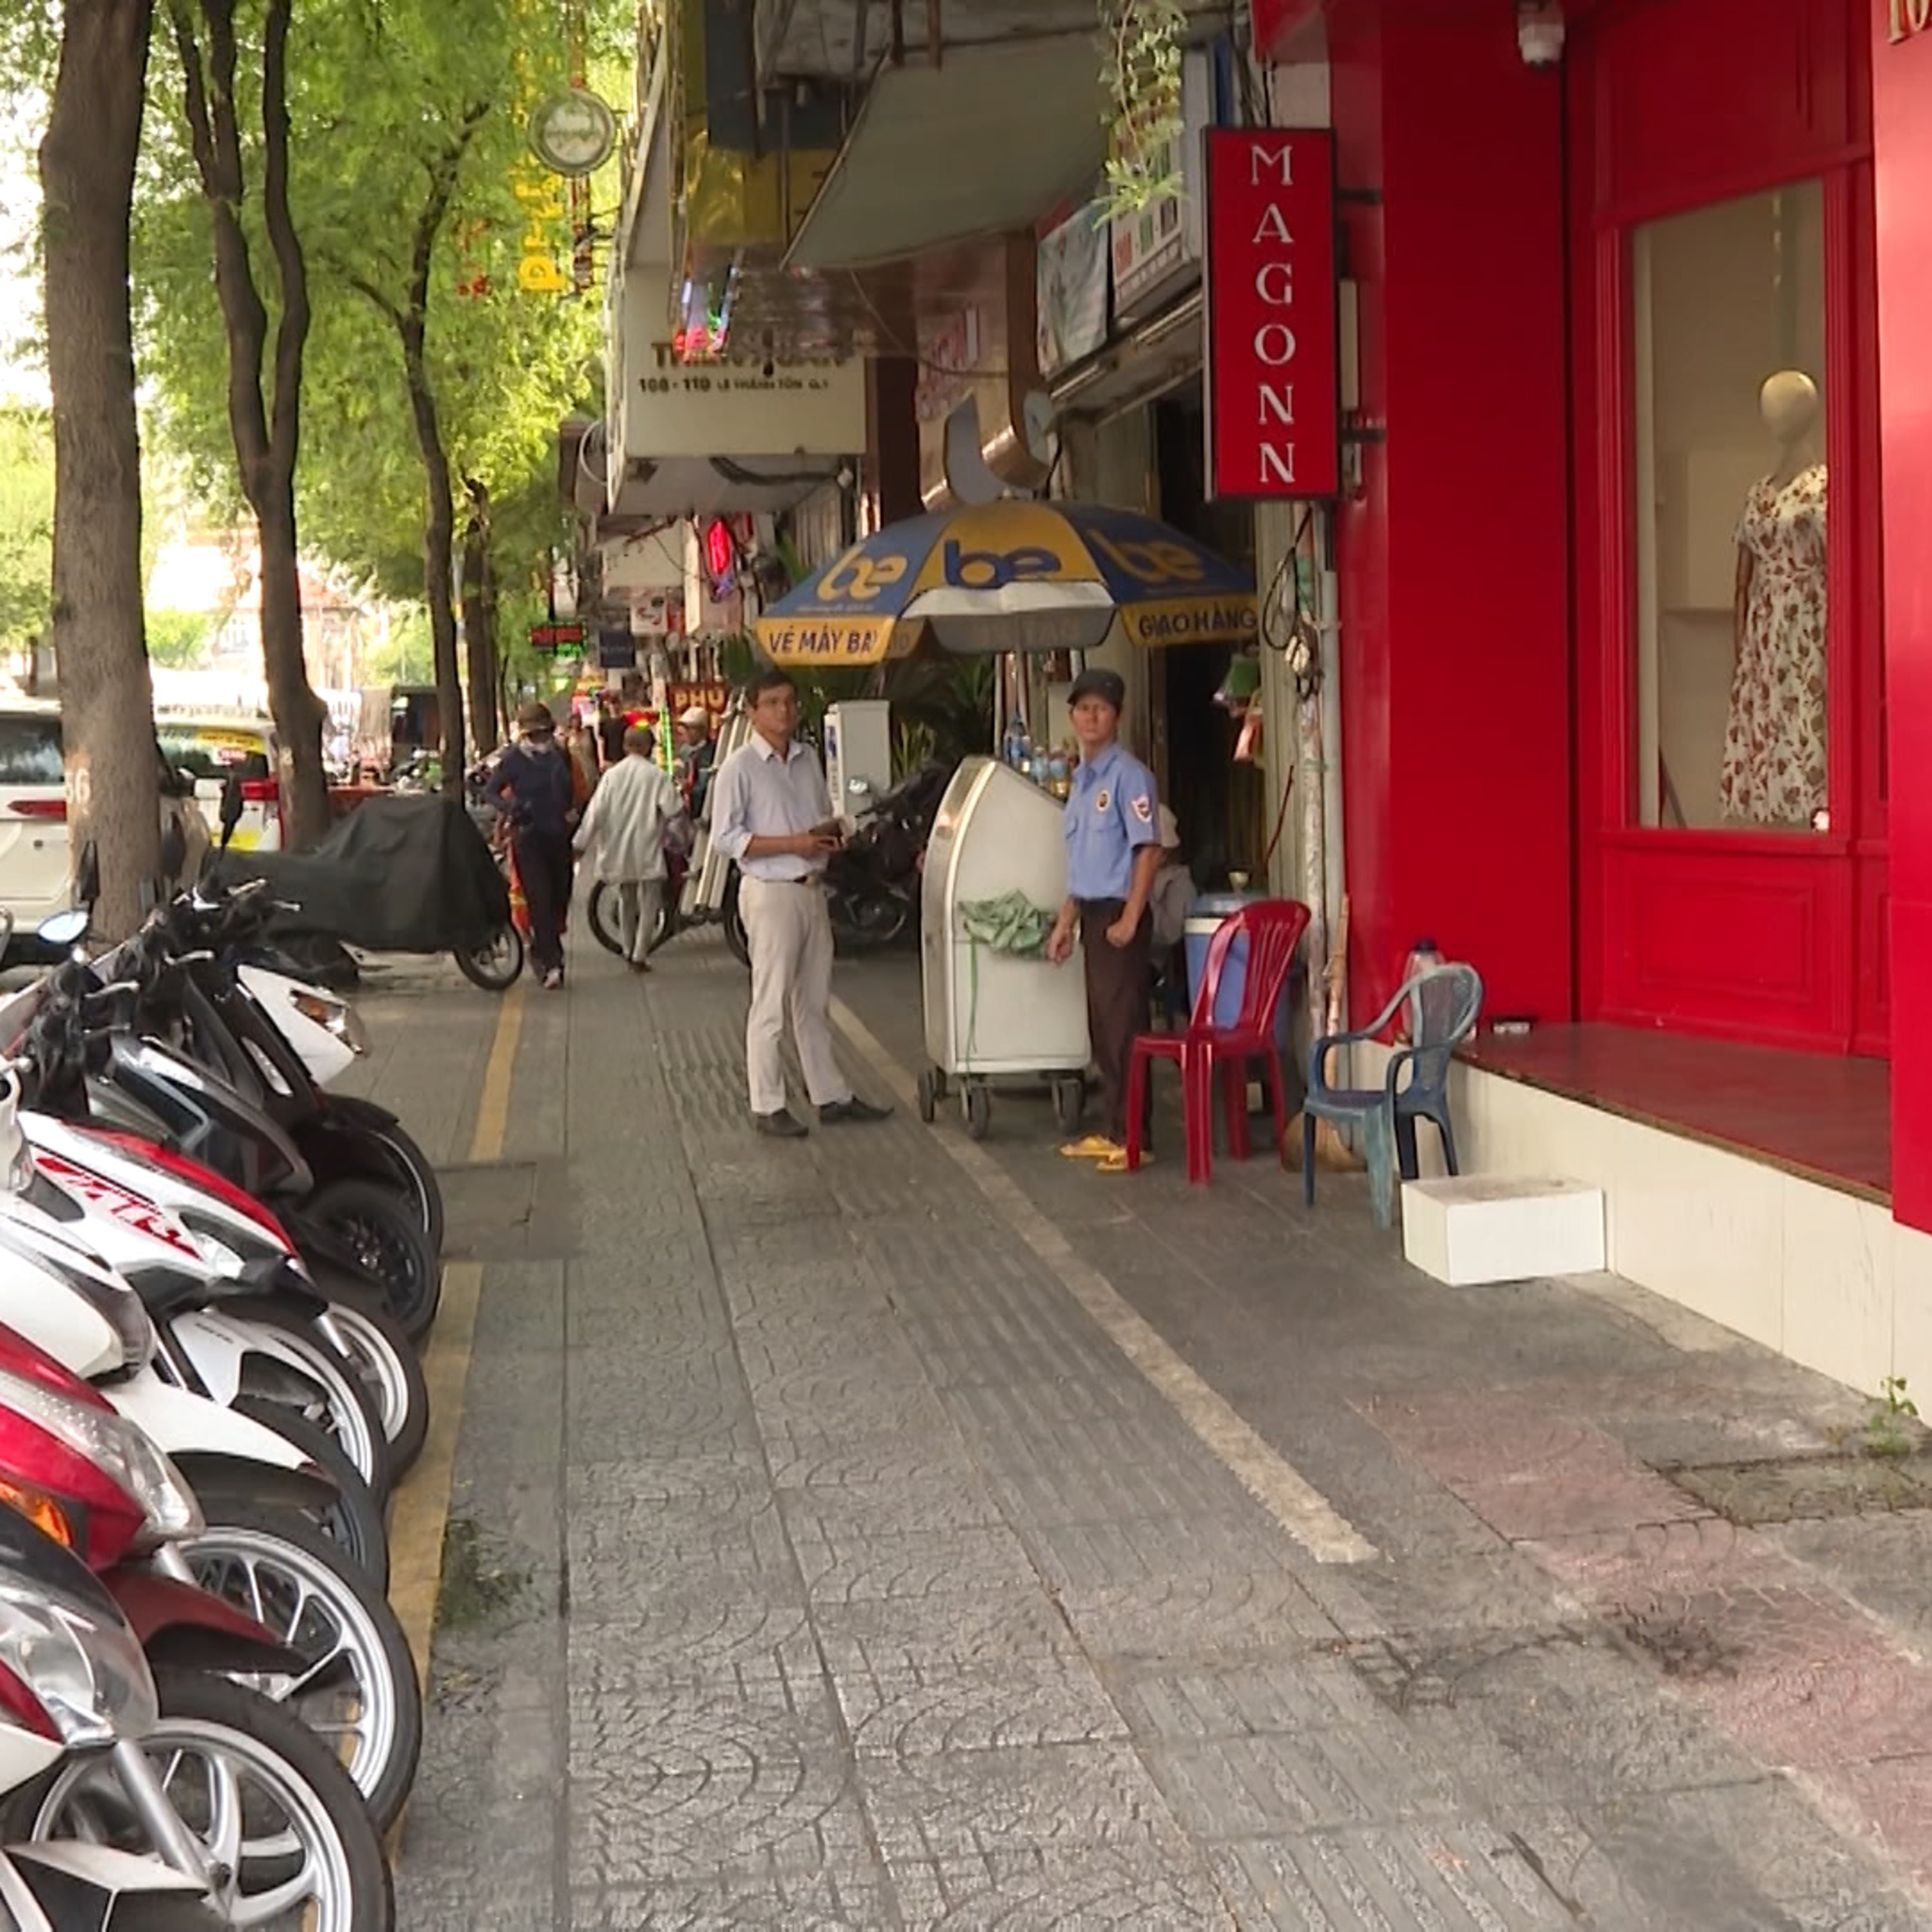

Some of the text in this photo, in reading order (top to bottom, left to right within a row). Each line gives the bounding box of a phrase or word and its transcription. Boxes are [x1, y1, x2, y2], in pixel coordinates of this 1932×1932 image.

[1251, 144, 1296, 483] MAGONN
[683, 378, 711, 392] 110
[817, 541, 907, 601] be
[944, 538, 1061, 589] be
[798, 623, 843, 654] MÁY
[1139, 600, 1256, 641] GIAO HÀNG
